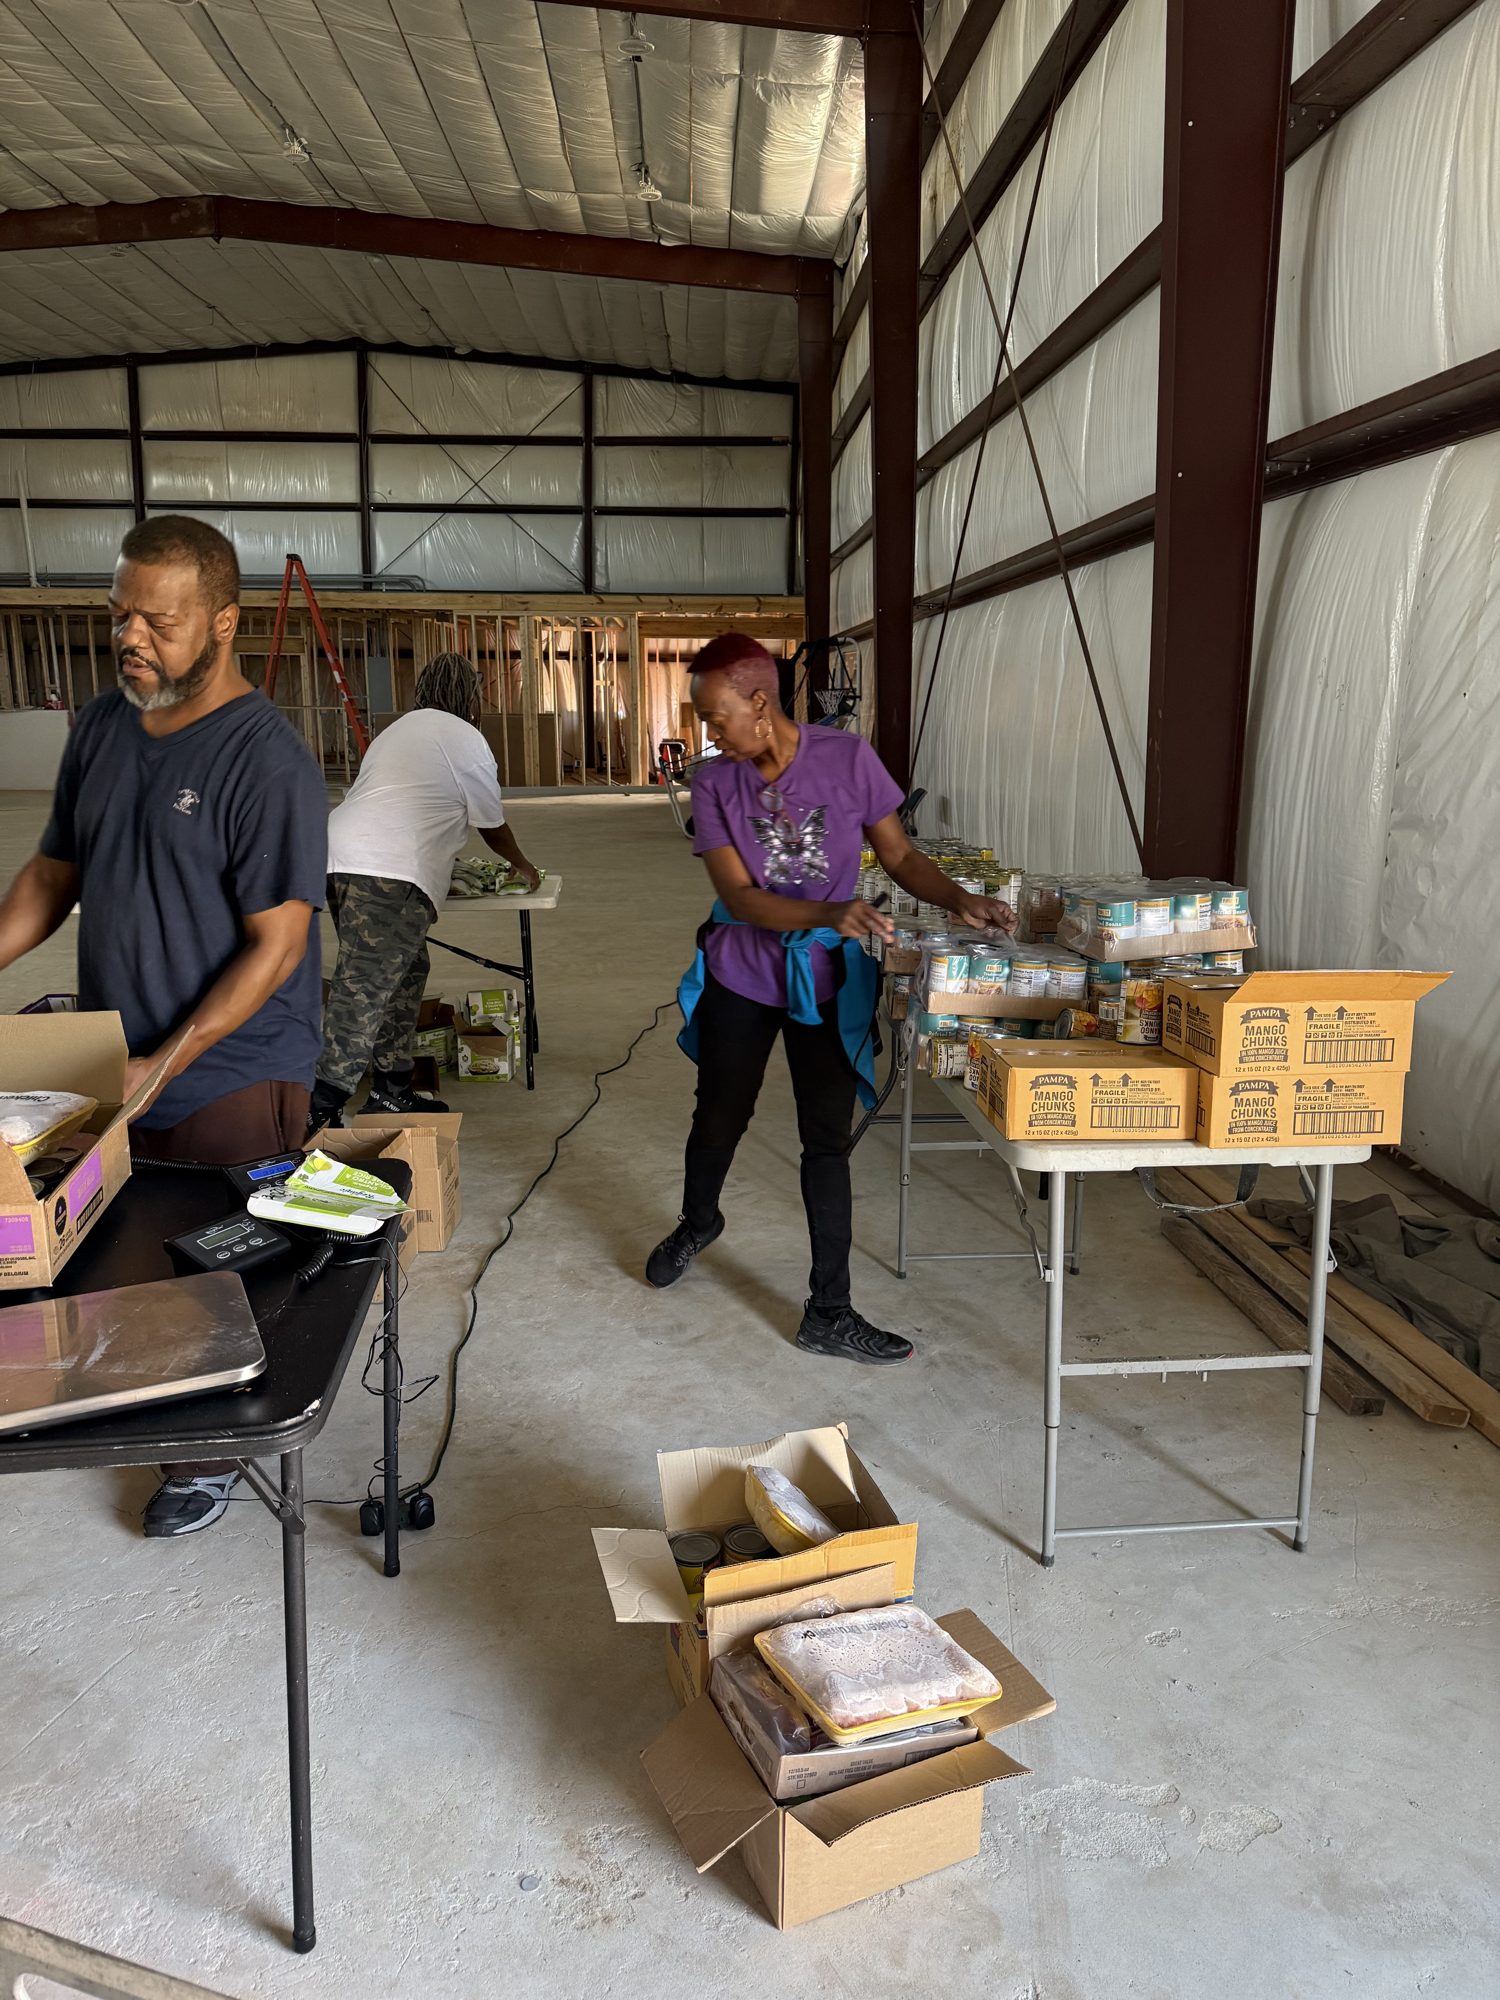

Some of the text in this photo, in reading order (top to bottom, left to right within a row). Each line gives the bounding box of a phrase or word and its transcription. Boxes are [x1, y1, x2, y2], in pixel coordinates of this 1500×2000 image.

[1250, 1009, 1281, 1018] PAMPA
[1245, 1024, 1285, 1036] MANGO
[1242, 1036, 1287, 1048] CHUNKS
[1038, 1076, 1069, 1085] PAMPA
[1239, 1081, 1269, 1090] PAMPA
[1034, 1090, 1074, 1101] MANGO
[1031, 1102, 1075, 1112] CHUNKS
[1234, 1096, 1274, 1108] MANGO
[1231, 1108, 1277, 1120] CHUNKS
[352, 1176, 391, 1190] CILANTRO
[862, 1619, 909, 1632] Chicken
